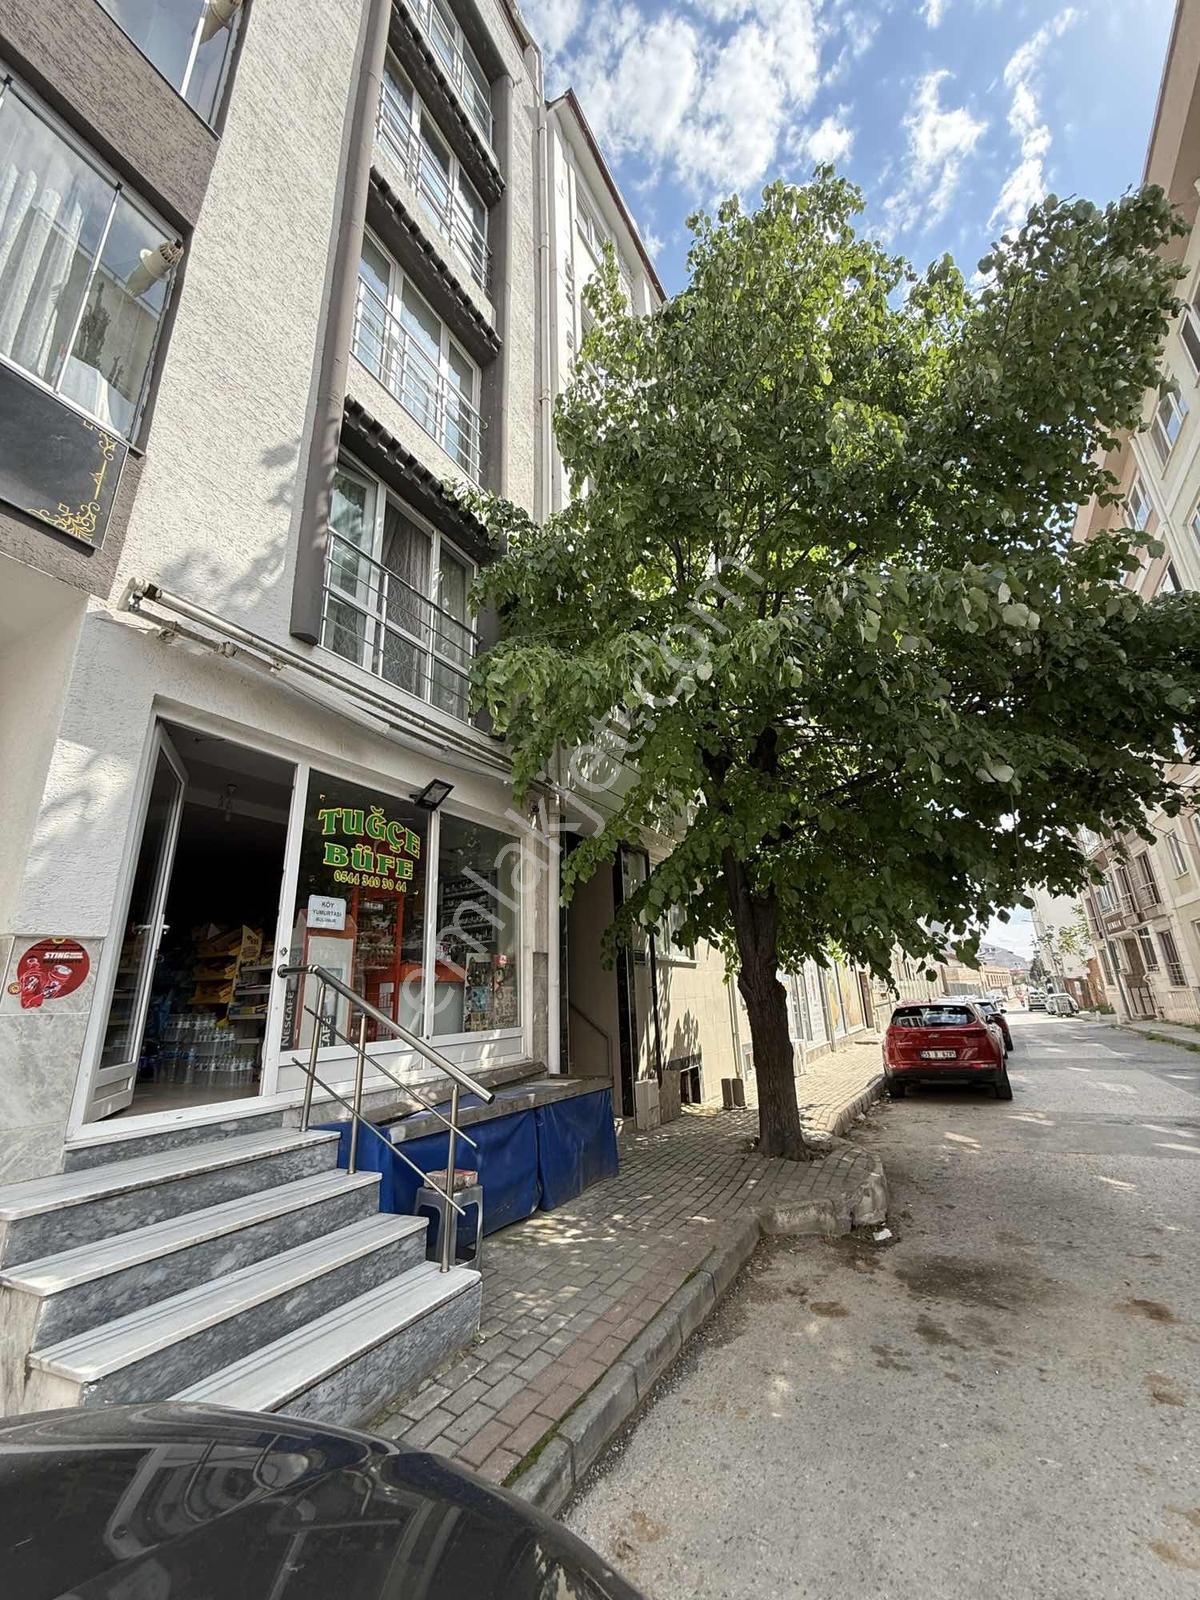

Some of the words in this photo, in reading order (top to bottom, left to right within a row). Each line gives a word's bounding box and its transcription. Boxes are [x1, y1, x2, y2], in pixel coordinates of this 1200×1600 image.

[318, 805, 420, 859] TUĞÇE
[323, 842, 413, 880] BÜFE
[334, 870, 360, 885] 0544
[395, 881, 407, 893] 44
